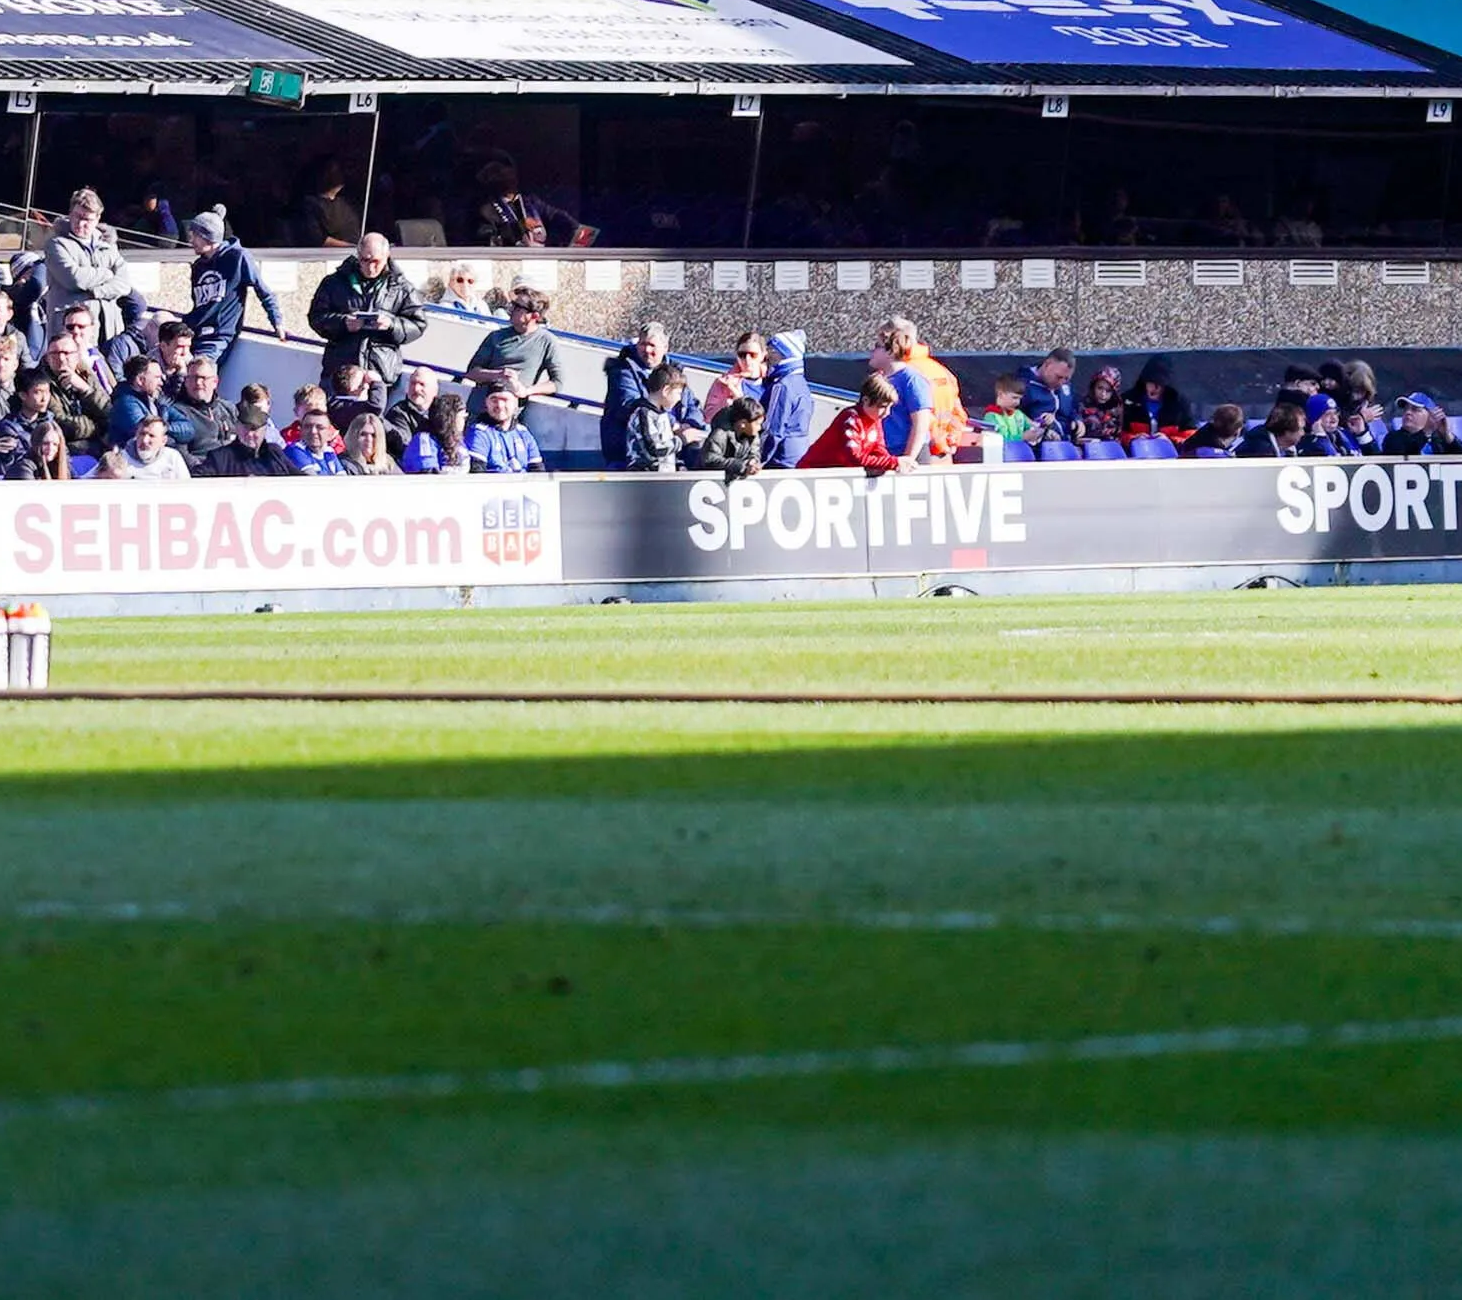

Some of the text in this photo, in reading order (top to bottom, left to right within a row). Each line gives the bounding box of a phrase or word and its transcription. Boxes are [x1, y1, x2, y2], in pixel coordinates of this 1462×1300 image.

[1052, 25, 1229, 48] TOUR
[15, 92, 33, 109] L5
[356, 93, 372, 107] L6
[738, 95, 754, 111] L7
[1047, 97, 1064, 113] L8
[1432, 103, 1448, 118] L9
[484, 504, 540, 529] SEH
[688, 473, 1026, 551] SPORTFIVE
[12, 499, 463, 575] SEHBAC.com
[485, 531, 540, 560] BAC
